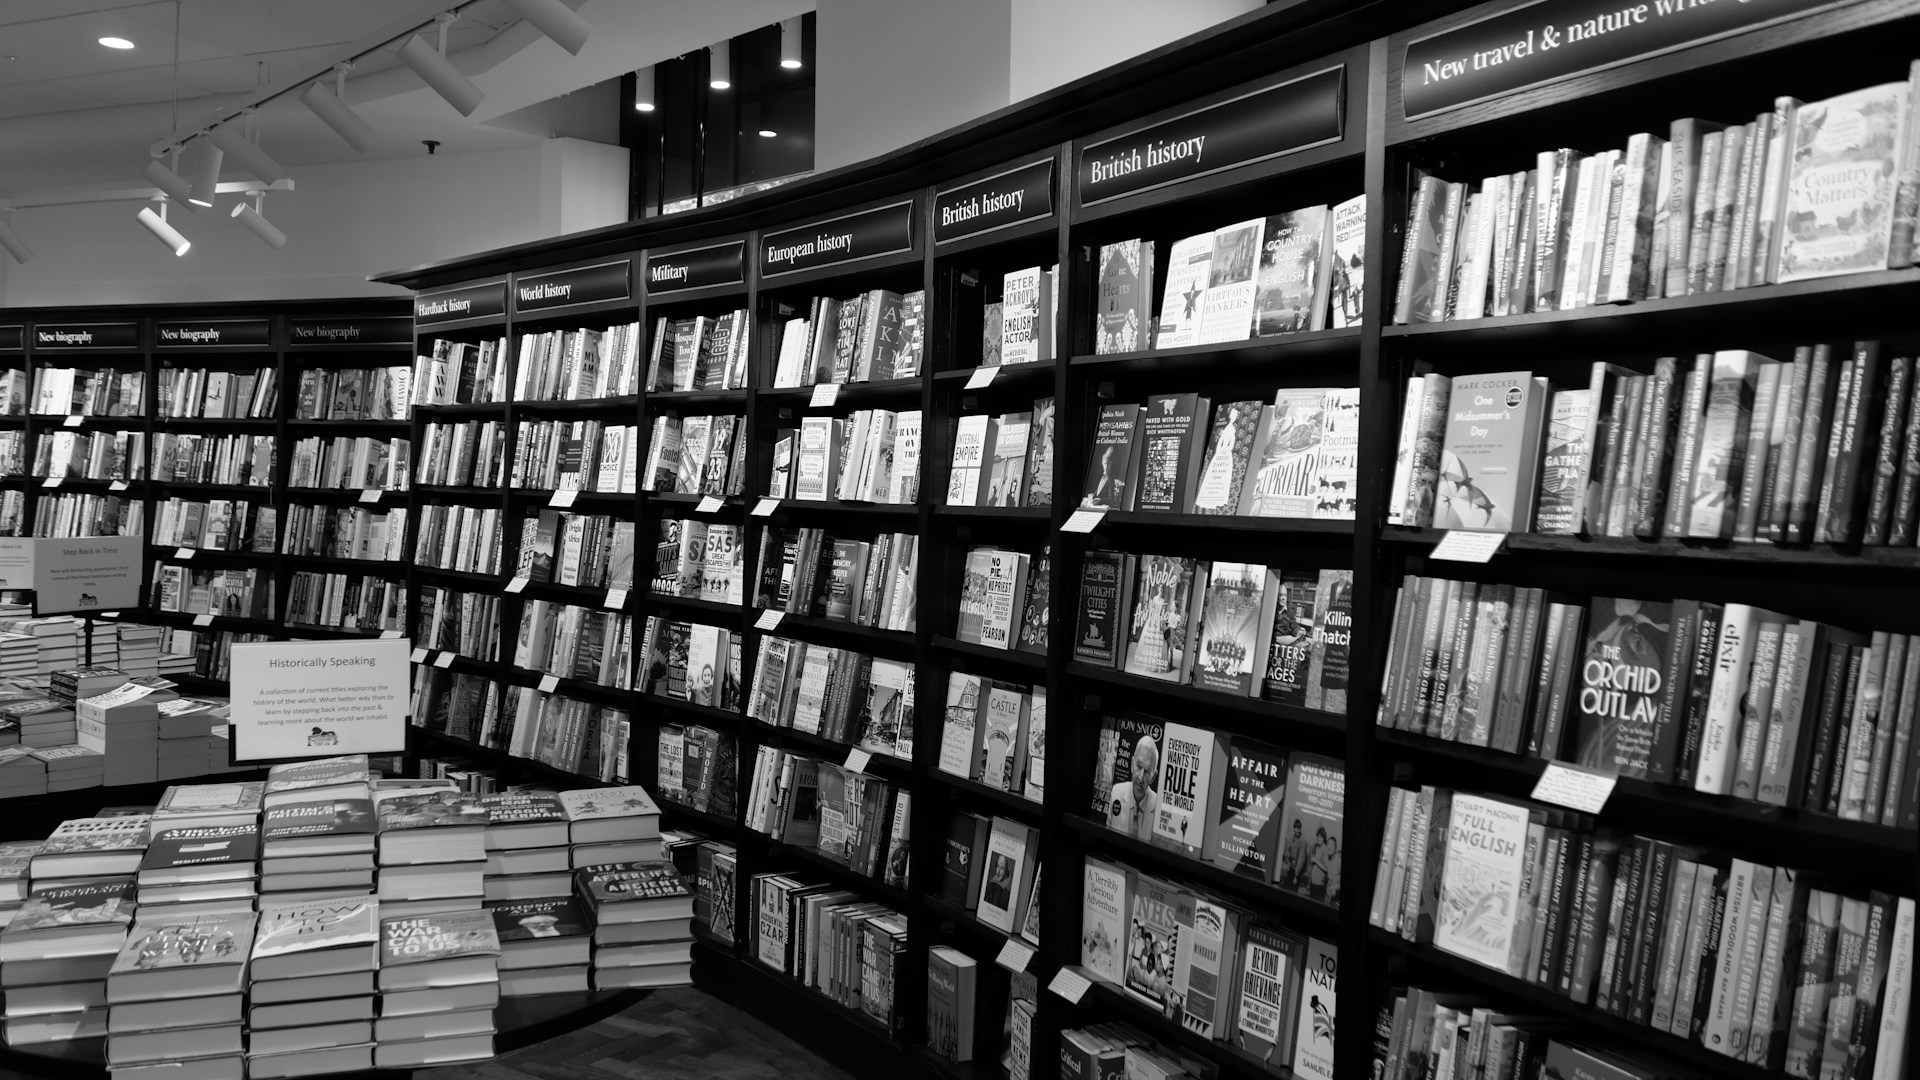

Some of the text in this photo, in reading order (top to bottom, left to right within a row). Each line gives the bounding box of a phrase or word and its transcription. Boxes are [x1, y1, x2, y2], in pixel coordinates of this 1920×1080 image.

[1423, 56, 1469, 85] New
[1473, 31, 1535, 71] travel
[1540, 25, 1561, 50] &
[1567, 2, 1649, 43] nature
[1090, 135, 1206, 184] British history
[1805, 166, 1872, 190] Country
[1672, 159, 1683, 216] SEASIDE
[1807, 185, 1869, 205] Matters
[942, 188, 1024, 226] British history
[1336, 203, 1361, 221] ATTACK
[1278, 228, 1292, 236] HOW
[1336, 214, 1366, 232] WARNING
[767, 232, 853, 264] European history
[1267, 233, 1314, 251] COUNTRY
[1271, 250, 1303, 264] HOUSE
[651, 264, 689, 282] Military
[1265, 271, 1304, 286] ENGLISH
[520, 282, 571, 301] World history
[1006, 276, 1034, 292] PETER
[1005, 287, 1034, 307] ACKROYD
[418, 298, 471, 317] Hardback history
[1206, 299, 1248, 314] BANKERS
[840, 317, 855, 329] LOVE
[1005, 316, 1032, 333] ENGLISH
[38, 331, 93, 345] New biography
[161, 328, 220, 342] New biography
[295, 326, 361, 341] New biography
[1004, 331, 1030, 345] ACTOR
[1457, 379, 1518, 391] MARK COCKER
[1474, 396, 1493, 406] One
[1847, 368, 1865, 427] BATHYSPHERE
[1455, 409, 1511, 421] Midsummer's
[1608, 395, 1624, 445] Deer Man
[1470, 426, 1489, 438] Day
[1829, 419, 1844, 458] WILD
[955, 446, 979, 460] EMPIRE
[708, 458, 722, 480] 23
[708, 536, 732, 553] SAS
[992, 558, 1001, 566] NO
[1148, 562, 1178, 588] Noble
[1083, 586, 1116, 598] TWILIGHT
[1088, 598, 1108, 610] CITIES
[982, 626, 1005, 641] PEARSON
[1457, 628, 1468, 669] MUSHROOM
[1602, 645, 1621, 660] THE
[1719, 623, 1741, 674] elixir
[269, 656, 376, 668] Historically Speaking
[1267, 666, 1295, 682] AGES
[1417, 650, 1433, 714] DAVID GRANN
[1583, 659, 1661, 694] ORCHID
[348, 685, 376, 694] exploring
[1434, 652, 1451, 717] DAVID GRANN
[253, 699, 275, 707] history
[990, 698, 1016, 715] CASTLE
[1168, 738, 1202, 756] EVERYBODY
[1168, 754, 1199, 770] WANTS TO
[1232, 756, 1278, 778] AFFAIR
[1615, 756, 1628, 764] BEN
[701, 750, 711, 790] WORLD
[1163, 764, 1198, 799] RULE
[1252, 779, 1264, 789] THE
[1300, 773, 1345, 793] DARKNESS
[1163, 792, 1194, 812] THE WORLD
[1230, 788, 1271, 809] HEART
[491, 807, 547, 816] MAGGIE
[894, 802, 903, 834] RUBLE
[1455, 801, 1520, 823] STUART MACONIE
[1463, 814, 1495, 834] FULL
[1221, 842, 1266, 862] BILLINGTON
[1451, 829, 1517, 858] ENGLISH
[586, 863, 626, 872] LIFE
[592, 870, 673, 882] AFTERLIFE
[608, 878, 680, 892] ANCIENT
[1088, 870, 1118, 893] A Terribly
[1552, 855, 1566, 904] MARCHANT
[1574, 860, 1587, 910] MARCHANT
[634, 885, 687, 896] CHINA
[1091, 884, 1114, 901] Serious
[1150, 890, 1164, 903] OUR
[1734, 874, 1745, 915] BRITISH
[1087, 893, 1118, 915] Adventure
[1137, 896, 1175, 929] NHS
[388, 919, 430, 930] THE
[760, 912, 783, 929] ACCIDENTAL
[388, 926, 441, 937] WAR
[388, 932, 459, 946] CAME
[760, 921, 784, 944] CZAR
[864, 930, 874, 950] THE
[389, 945, 420, 956] TO
[863, 948, 876, 968] WAR
[1252, 947, 1278, 976] BEYOND
[862, 962, 880, 986] CAME
[1244, 971, 1281, 1006] GRIEVANCE
[1061, 1048, 1081, 1074] Critical
